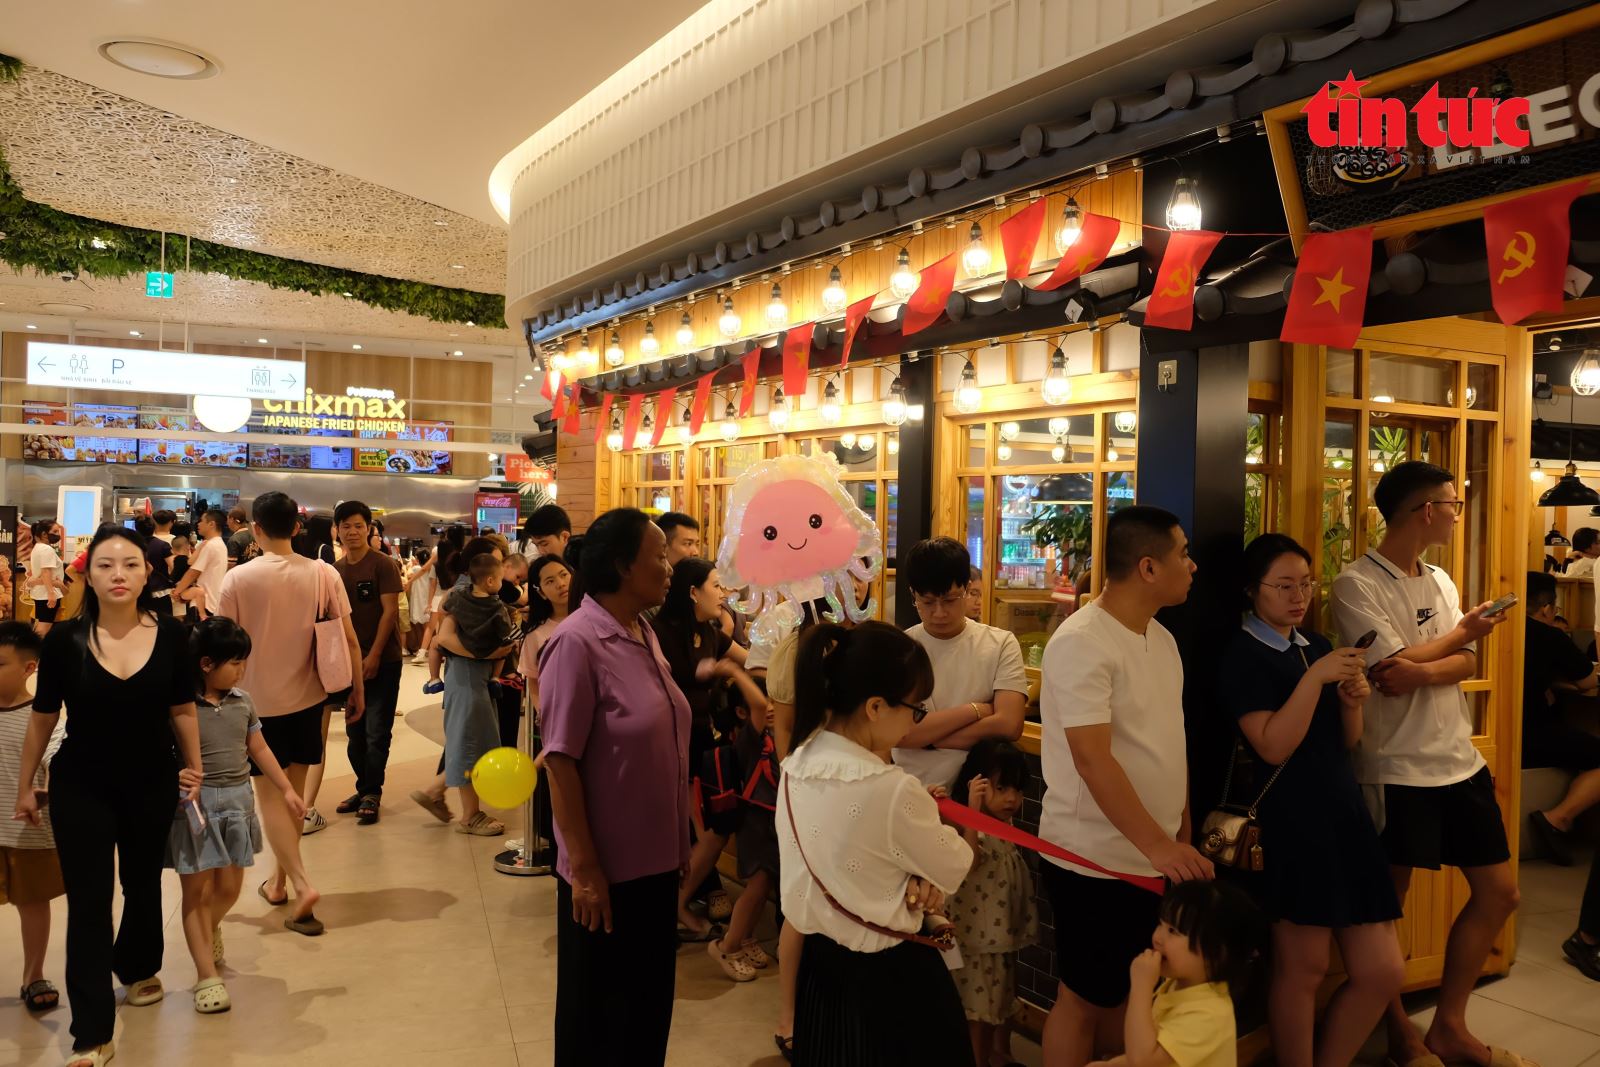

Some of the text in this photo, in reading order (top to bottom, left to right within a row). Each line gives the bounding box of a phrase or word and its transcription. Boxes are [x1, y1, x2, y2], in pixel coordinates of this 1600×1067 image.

[112, 358, 125, 375] P
[262, 414, 321, 430] JAPANESE
[322, 418, 355, 432] FRIED
[355, 419, 406, 433] CHICKEN
[519, 468, 550, 479] here
